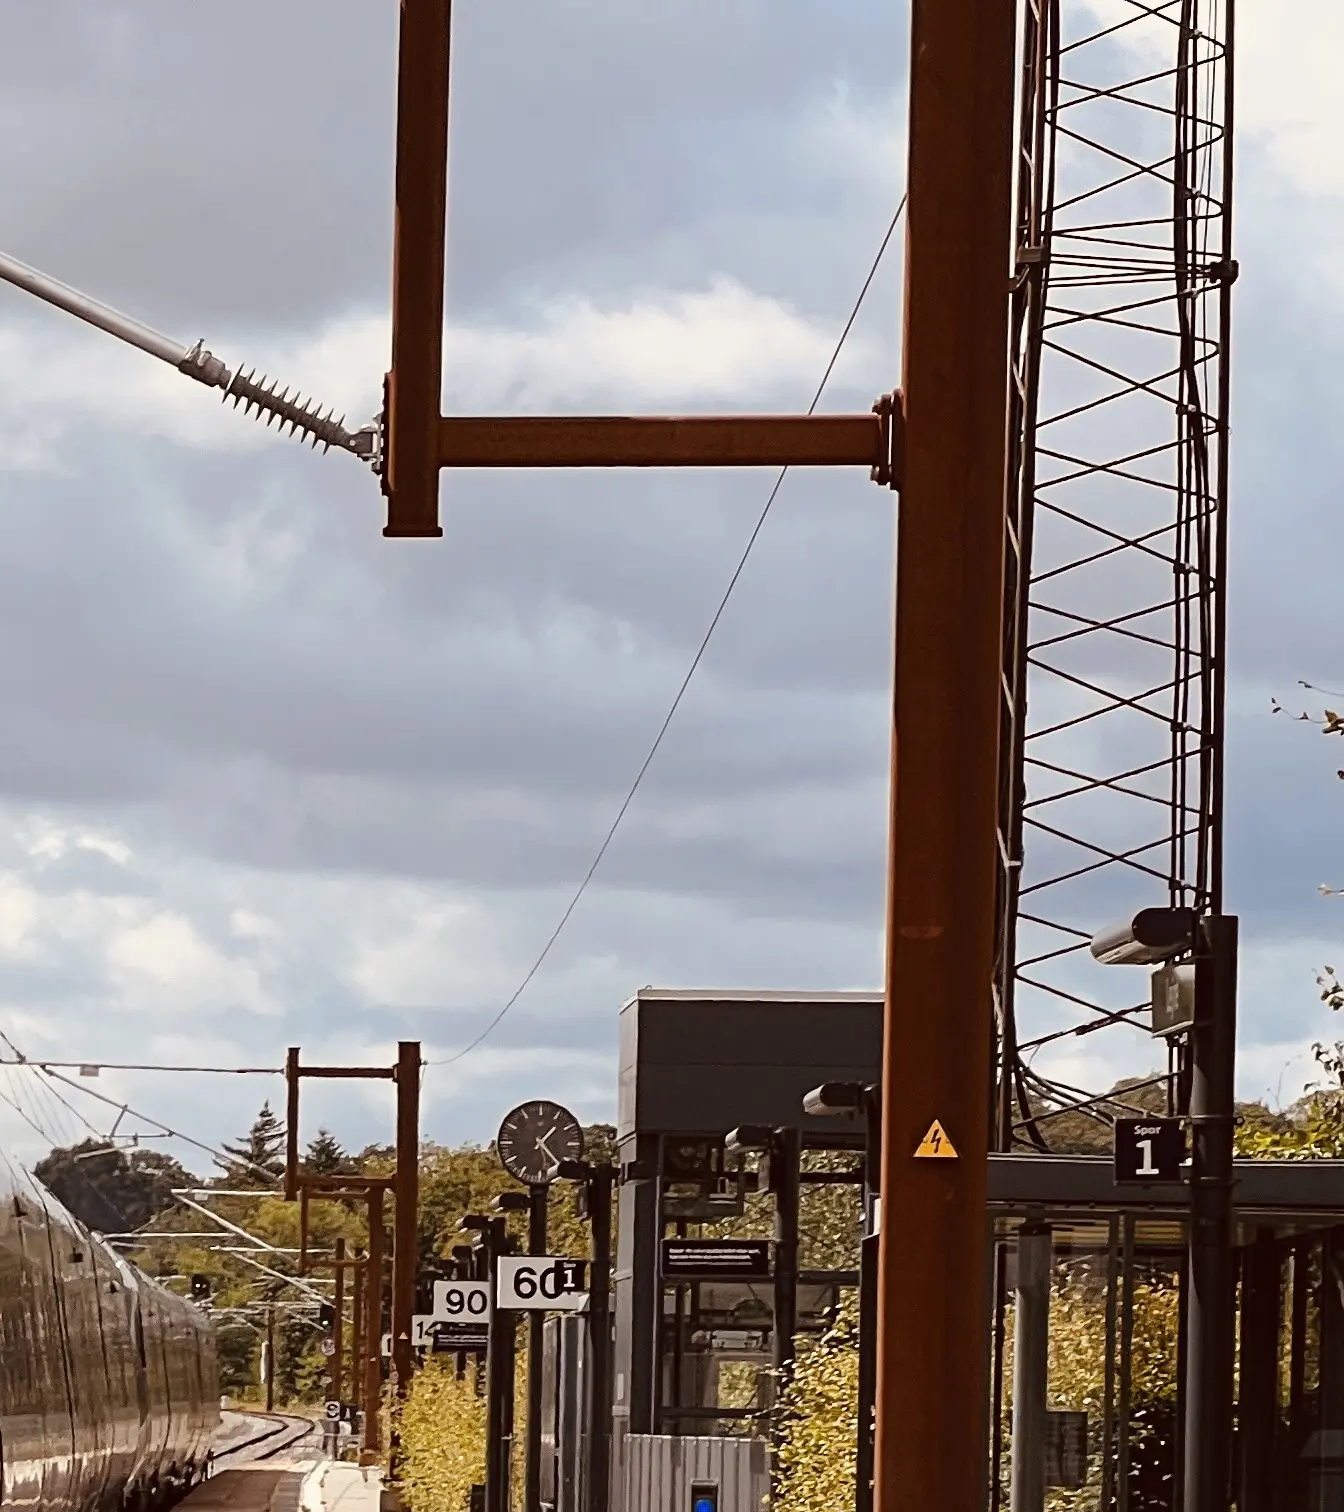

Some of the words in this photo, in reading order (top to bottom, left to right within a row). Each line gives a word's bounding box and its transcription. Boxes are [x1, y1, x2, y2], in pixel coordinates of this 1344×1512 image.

[1133, 1124, 1162, 1137] Spor
[1135, 1139, 1160, 1175] 1
[563, 1268, 576, 1288] 1
[445, 1288, 488, 1315] 90
